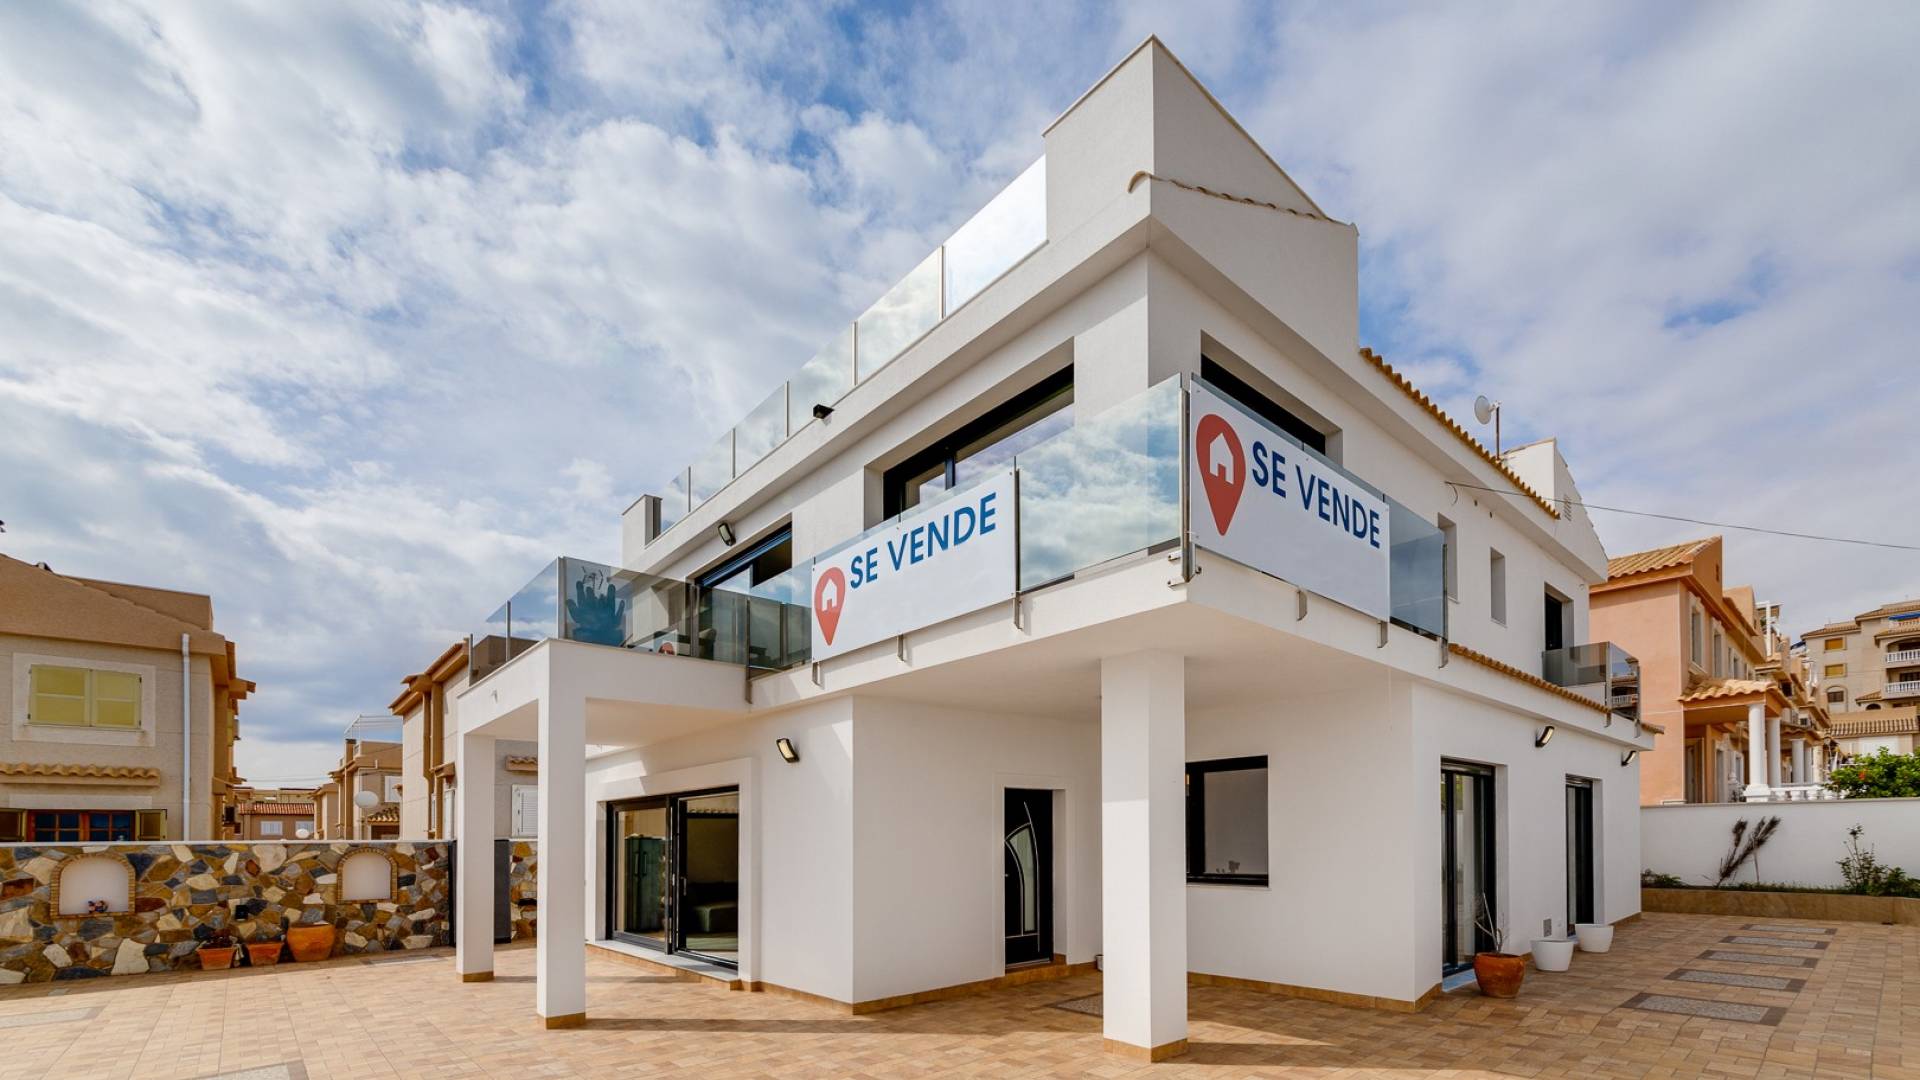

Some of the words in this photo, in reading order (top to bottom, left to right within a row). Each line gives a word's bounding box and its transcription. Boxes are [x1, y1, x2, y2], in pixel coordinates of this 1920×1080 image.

[850, 547, 878, 589] SE
[887, 492, 997, 572] VENDE
[1252, 440, 1286, 499] SE
[1295, 463, 1380, 549] VENDE
